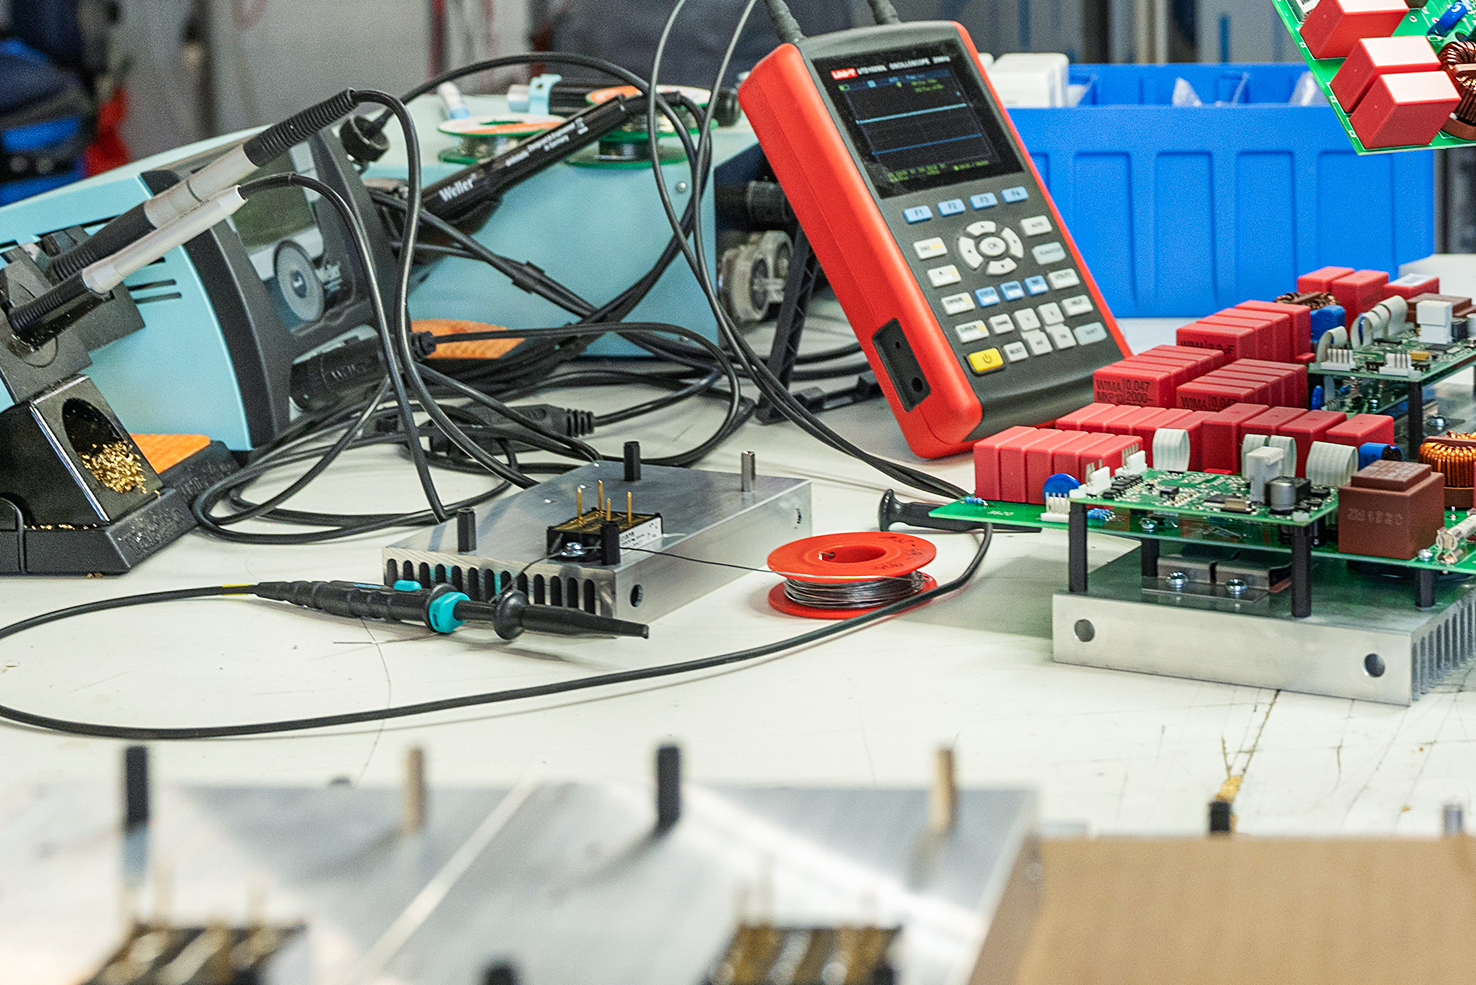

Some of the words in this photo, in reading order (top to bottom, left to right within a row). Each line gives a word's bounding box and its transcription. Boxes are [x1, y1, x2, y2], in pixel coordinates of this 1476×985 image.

[438, 175, 475, 202] Weller
[1011, 190, 1021, 198] F4
[980, 196, 990, 204] F3
[947, 203, 957, 211] F2
[1096, 379, 1122, 392] WIMA
[1180, 396, 1206, 410] WIMA
